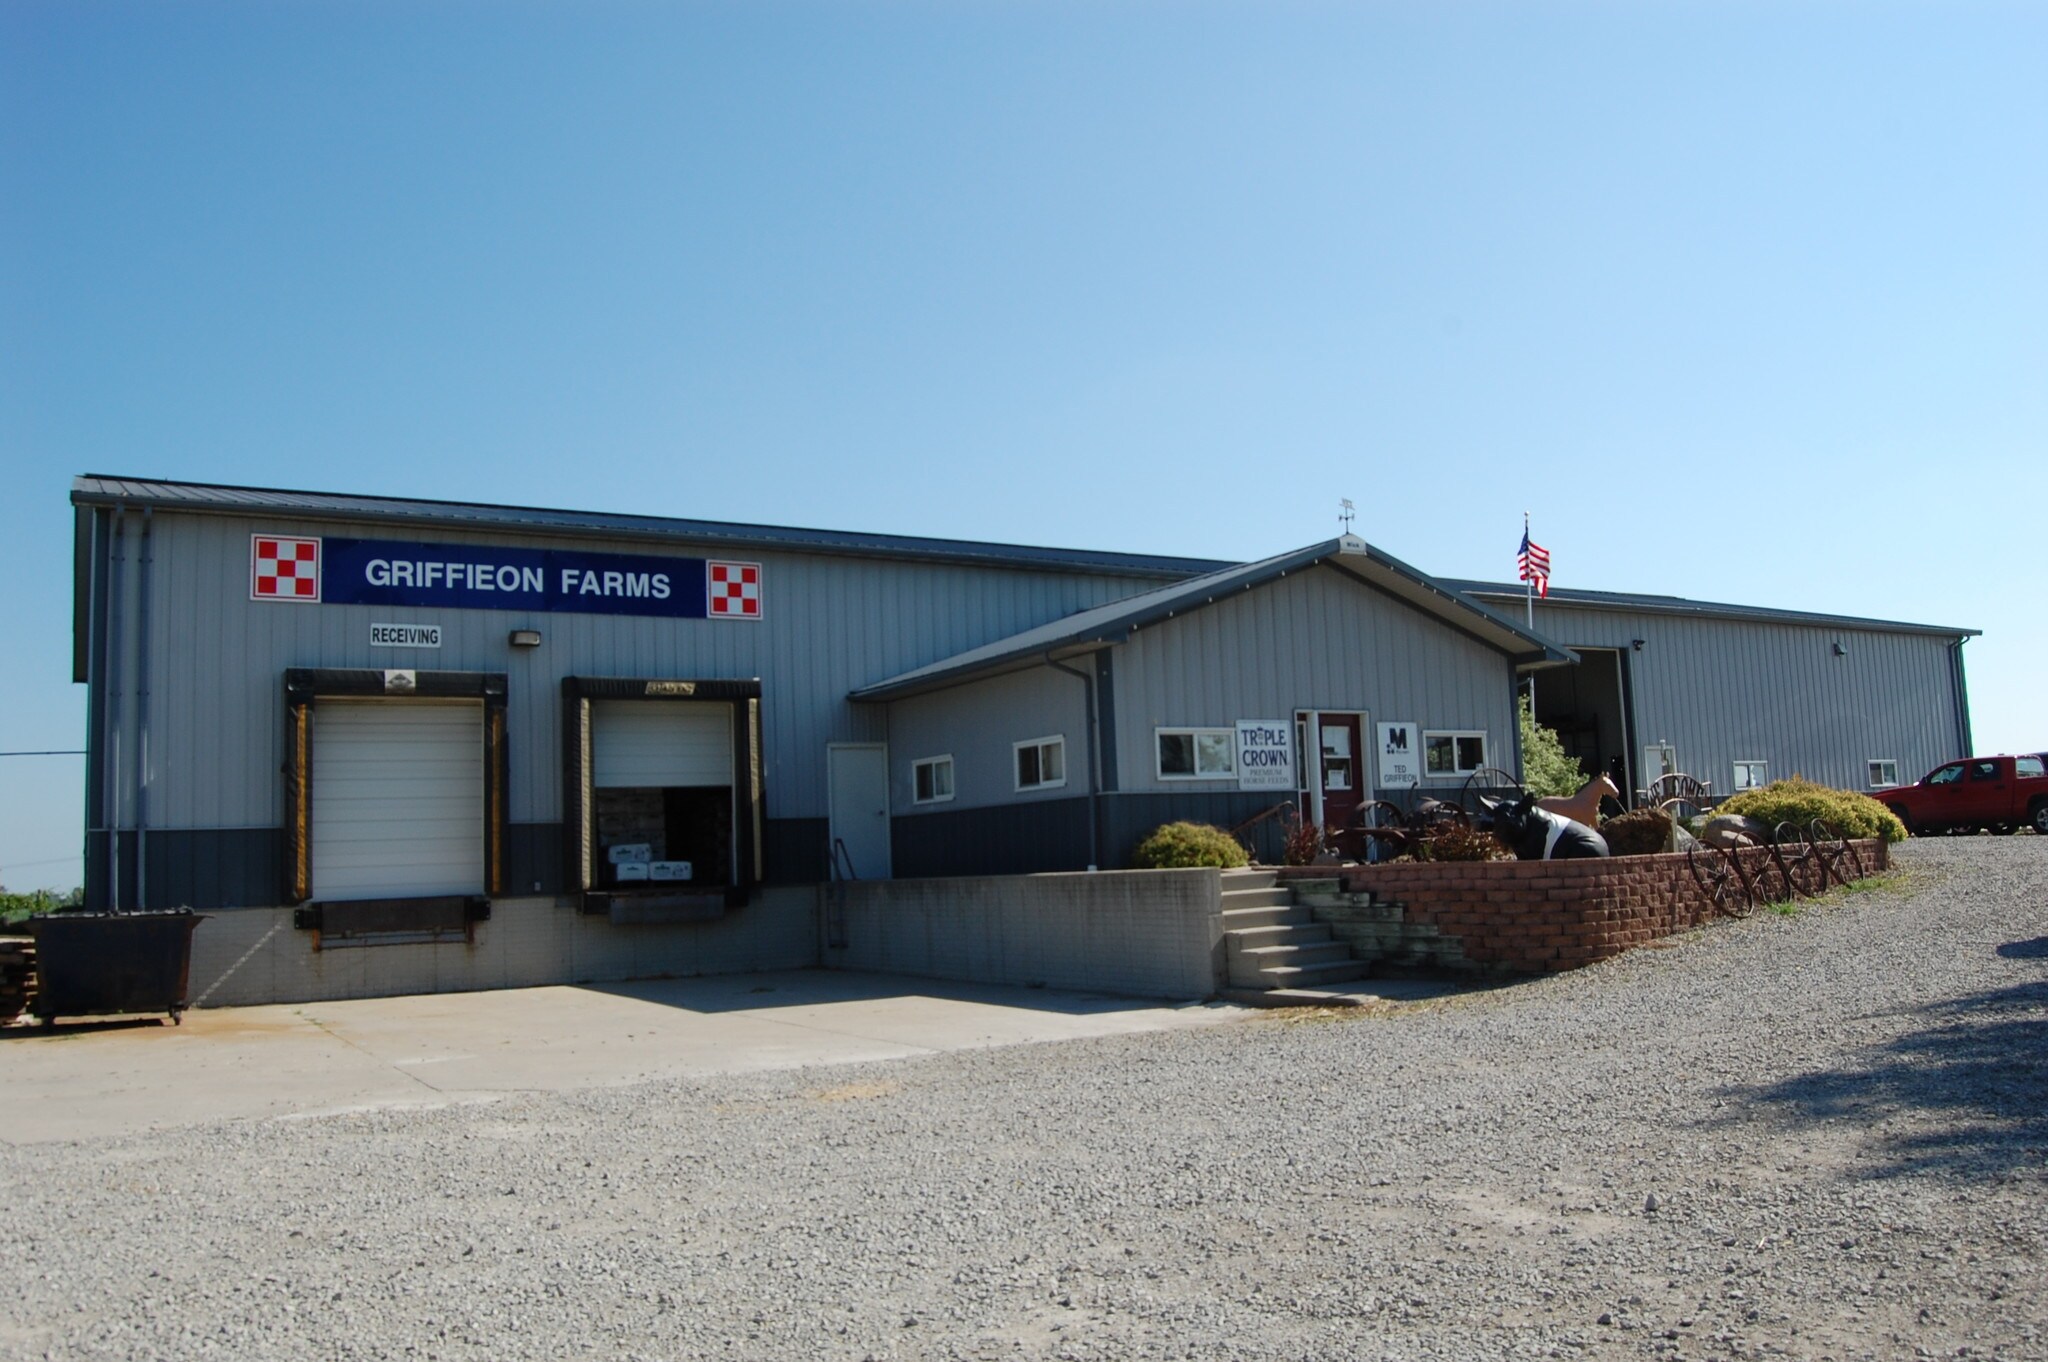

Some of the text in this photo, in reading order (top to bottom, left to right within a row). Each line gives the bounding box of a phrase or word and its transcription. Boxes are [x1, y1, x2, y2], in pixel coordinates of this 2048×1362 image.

[365, 559, 671, 600] GRIFFIEON FARMS
[372, 627, 439, 644] RECEIVING
[1241, 727, 1287, 746] TRIPLE
[1242, 749, 1288, 767] CROWN
[1249, 768, 1283, 776] PREMIUM
[1393, 764, 1407, 773] TED
[1243, 776, 1289, 784] HORSE FEEDS
[1383, 774, 1417, 783] GRIFFIEON
